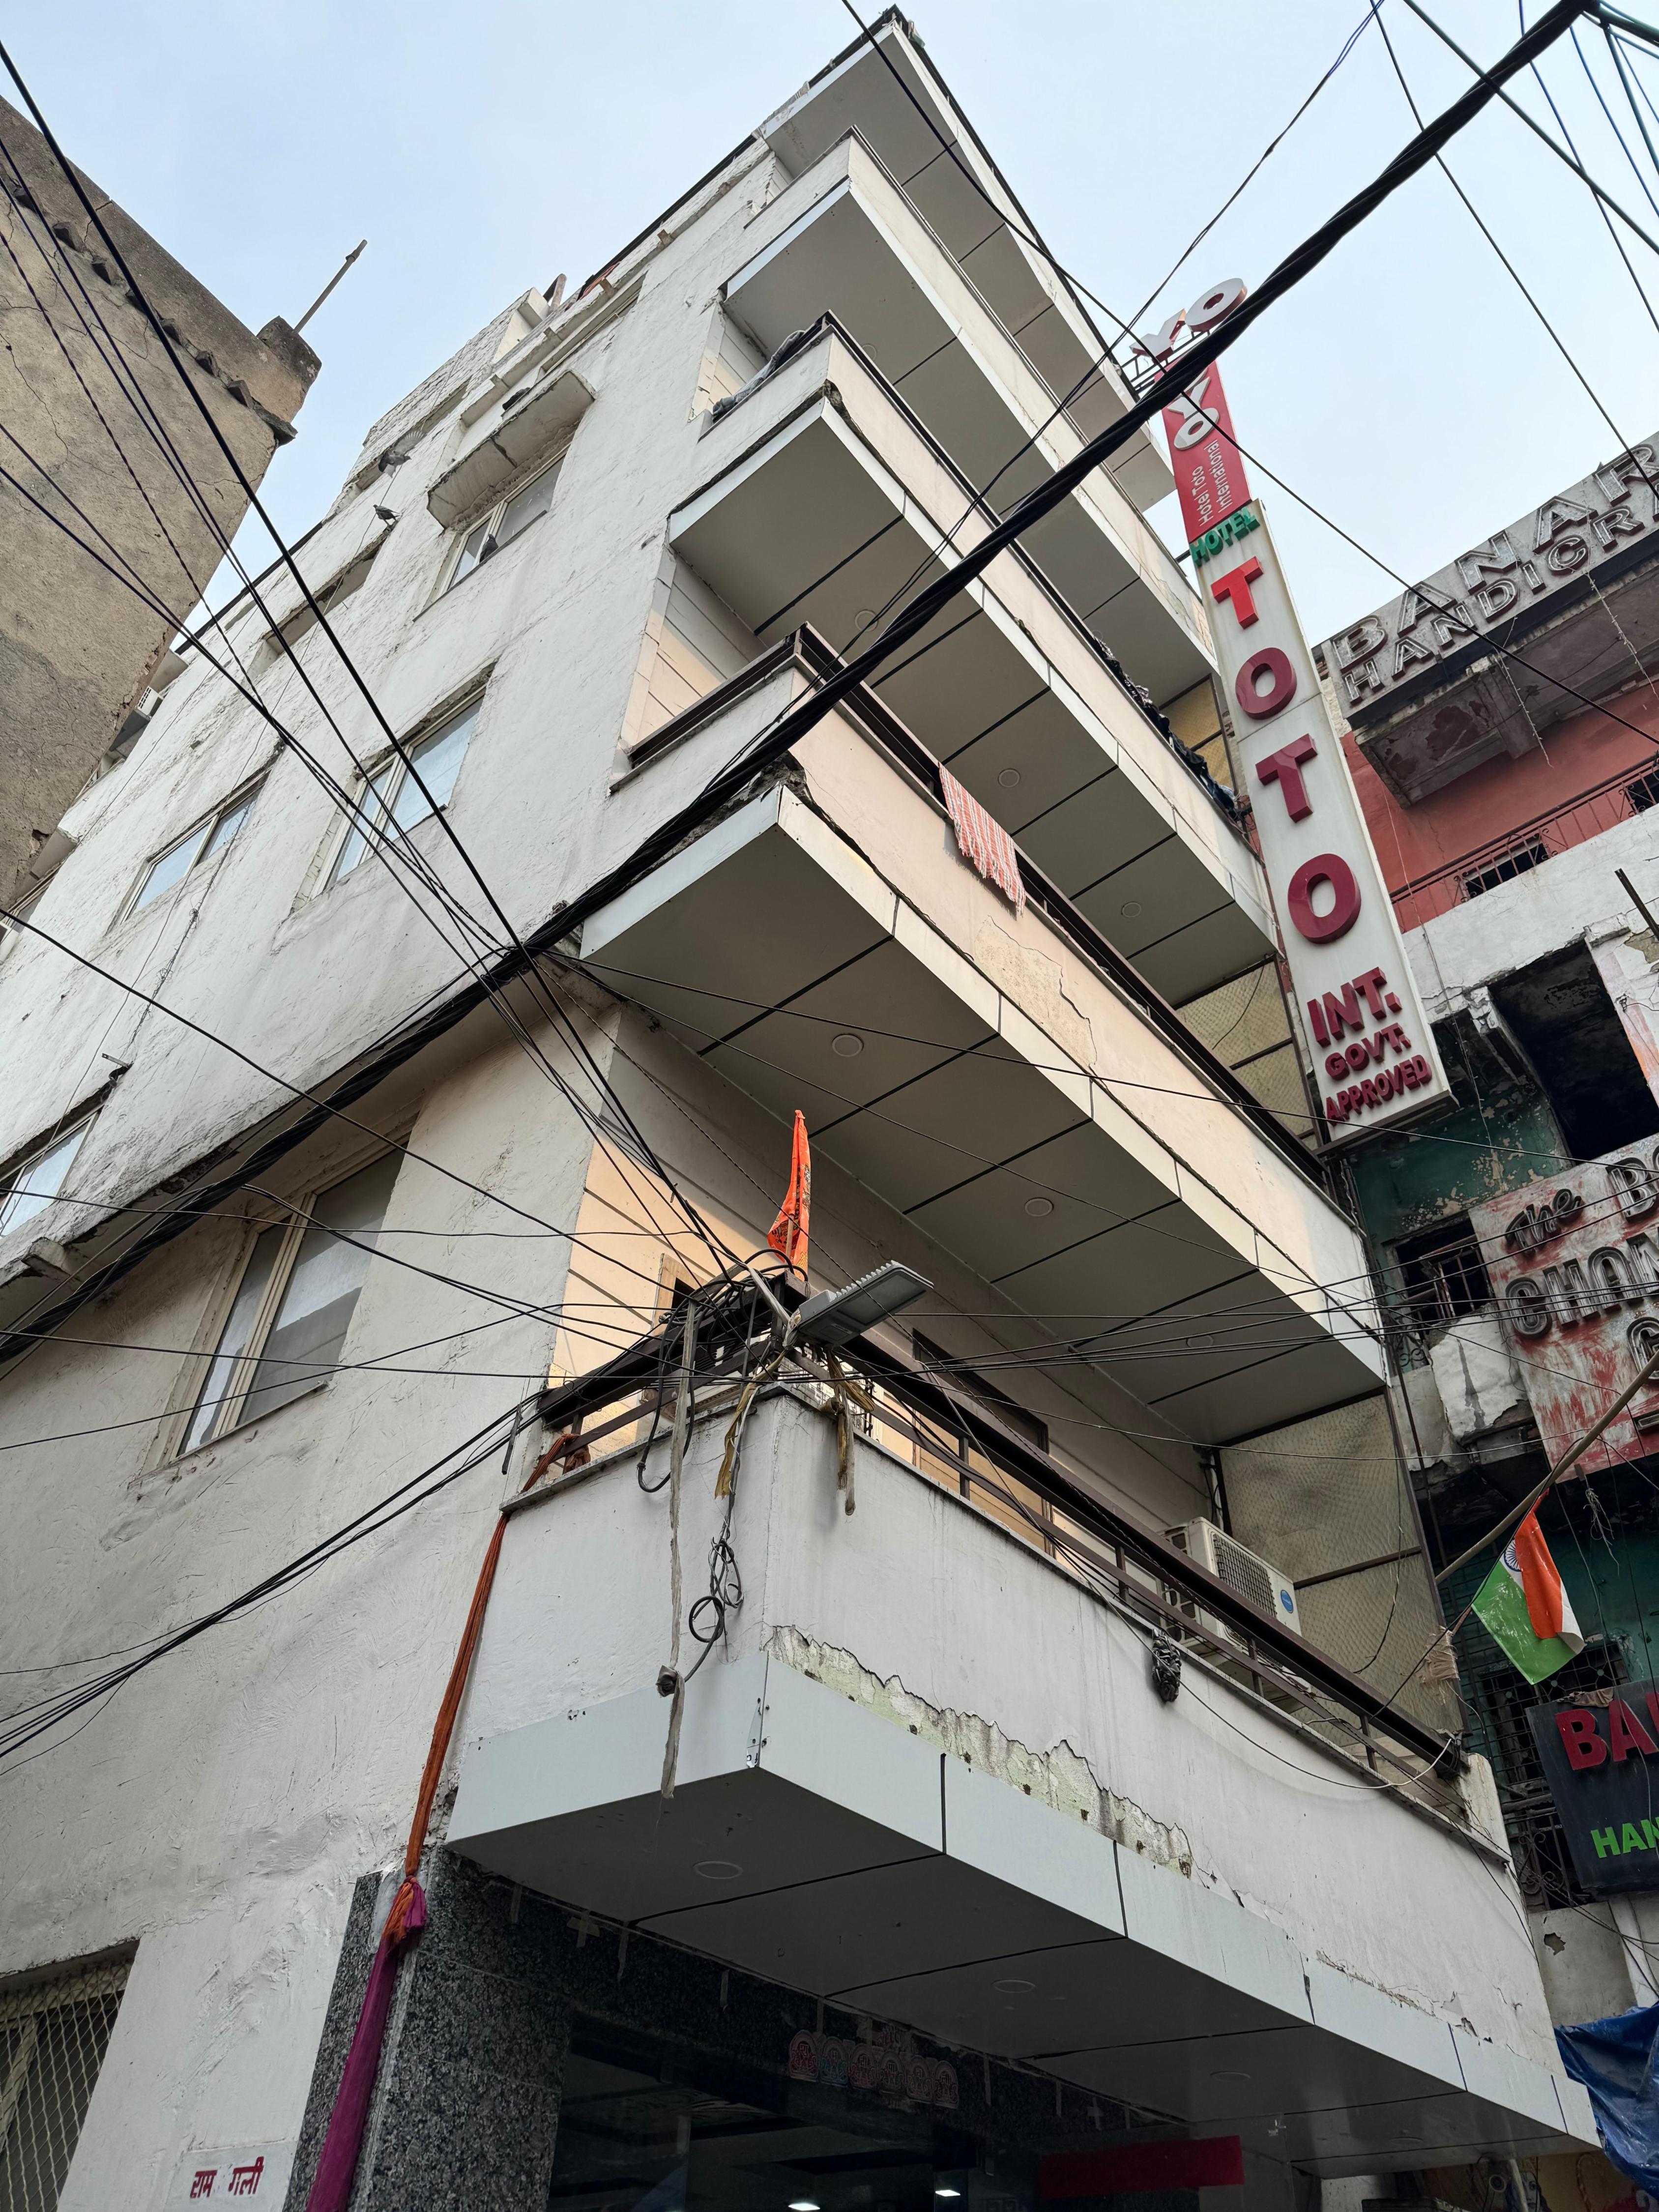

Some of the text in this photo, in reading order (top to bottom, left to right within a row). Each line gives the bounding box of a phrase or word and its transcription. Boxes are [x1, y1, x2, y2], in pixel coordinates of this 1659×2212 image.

[1167, 368, 1219, 450] OY
[1191, 466, 1215, 526] Hotel Toto
[1204, 439, 1233, 513] International
[1189, 506, 1260, 567] HOTEL
[1341, 482, 1659, 706] HANDICR
[1307, 966, 1403, 1048] INT.
[1325, 1054, 1432, 1126] APPROVED
[189, 2156, 264, 2199] राम गली
